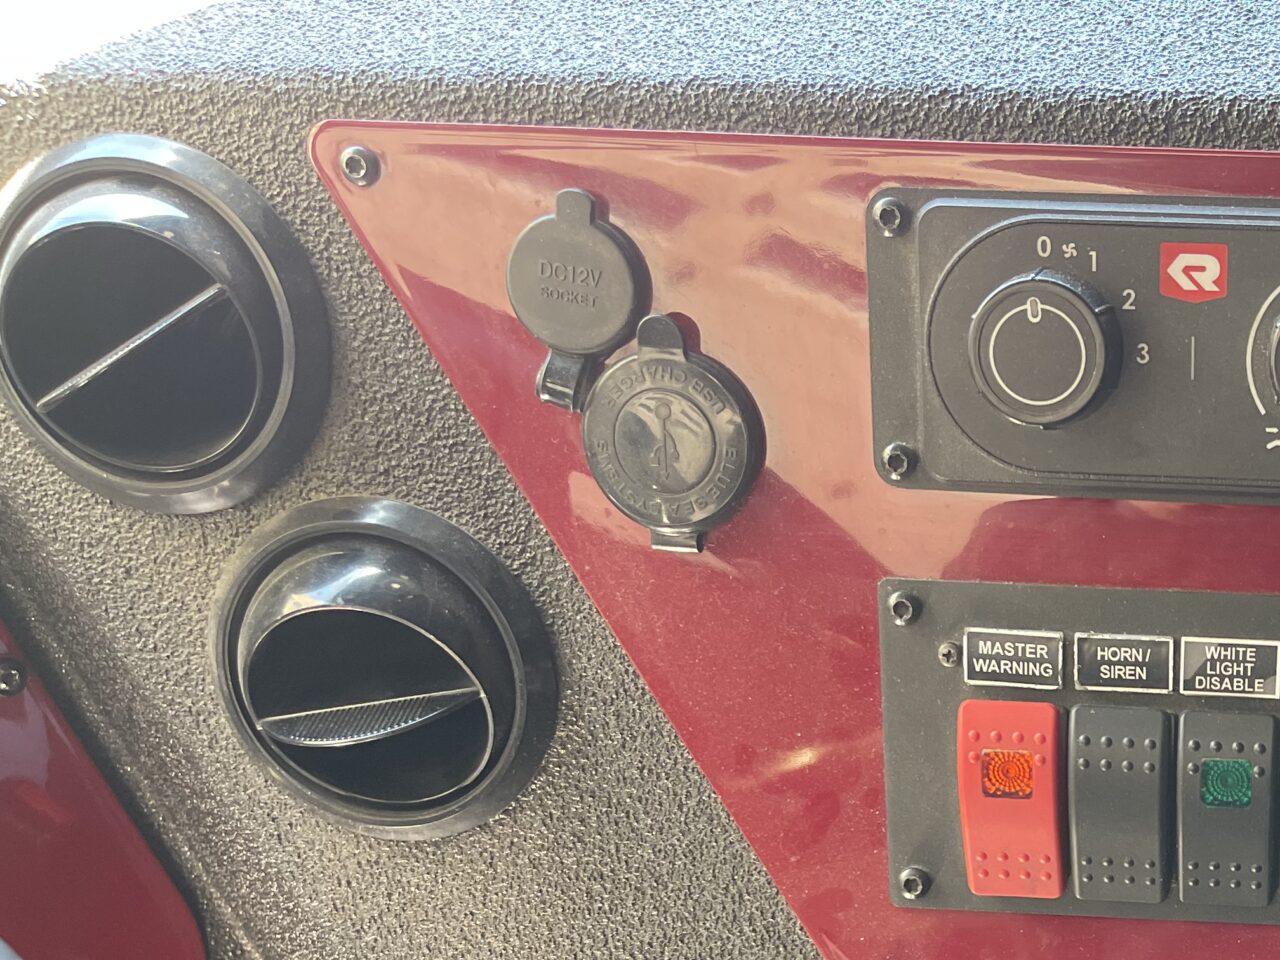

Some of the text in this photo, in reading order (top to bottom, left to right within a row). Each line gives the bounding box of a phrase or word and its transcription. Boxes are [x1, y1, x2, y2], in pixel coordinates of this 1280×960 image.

[1036, 236, 1051, 258] 0
[1088, 250, 1097, 272] 1
[540, 285, 599, 308] SOCKET
[1122, 288, 1136, 310] 2
[1136, 343, 1150, 365] 3
[688, 378, 726, 415] USB
[978, 640, 1049, 659] MASTER
[1204, 645, 1257, 662] WHITE
[972, 658, 1053, 677] WARNING
[1099, 664, 1147, 680] SIREN
[1206, 660, 1255, 677] LIGHT
[1194, 675, 1265, 693] DISABLE
